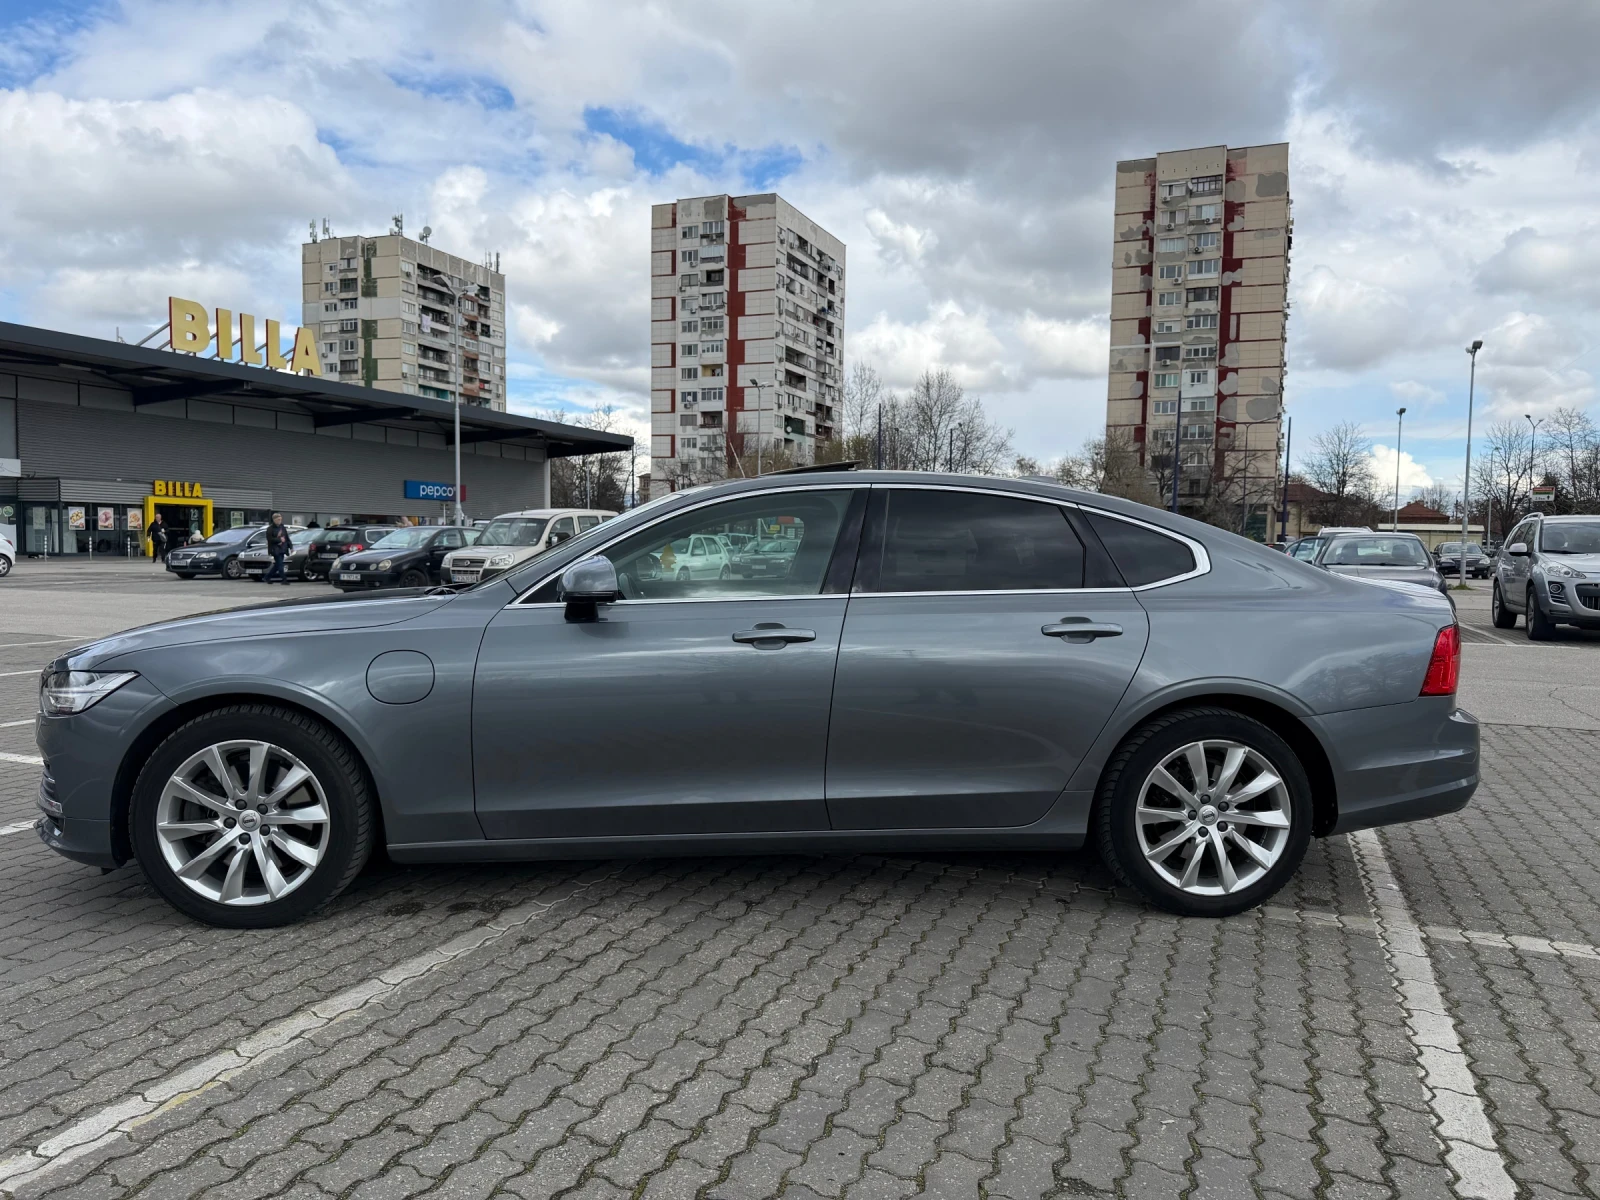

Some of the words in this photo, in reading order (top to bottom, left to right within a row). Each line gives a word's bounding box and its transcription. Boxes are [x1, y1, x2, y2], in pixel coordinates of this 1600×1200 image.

[169, 296, 322, 376] BILLA
[154, 480, 202, 497] BILLA
[420, 485, 454, 498] pepco
